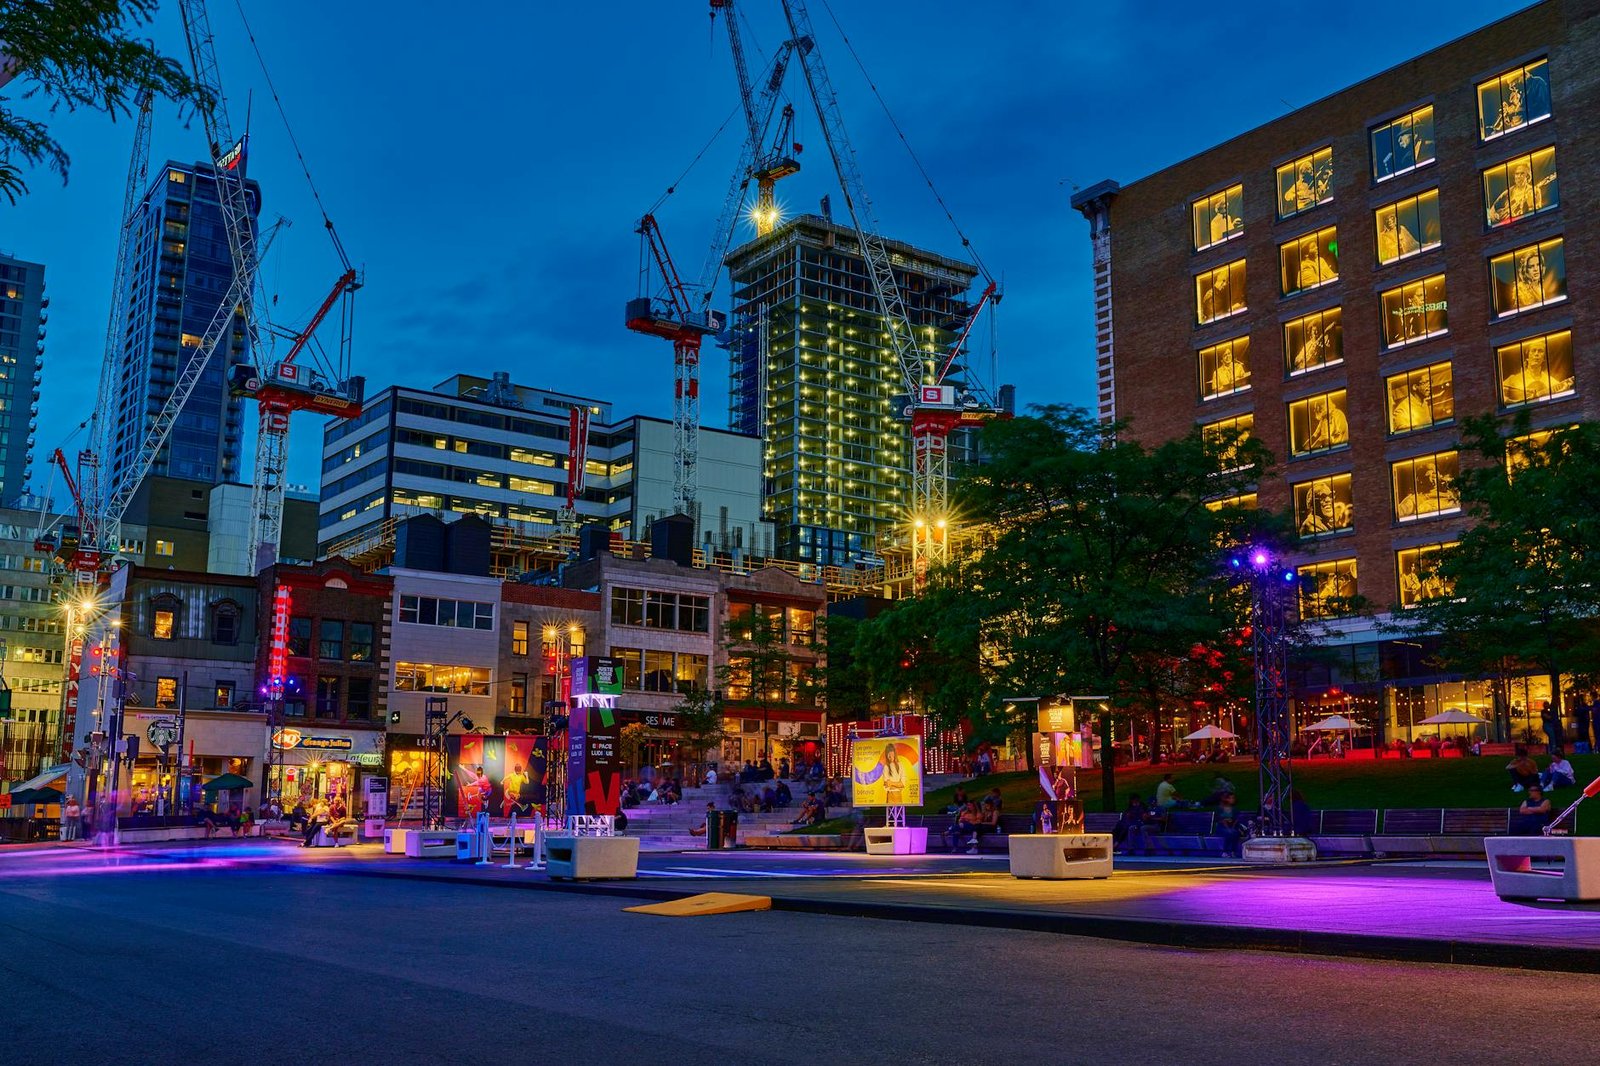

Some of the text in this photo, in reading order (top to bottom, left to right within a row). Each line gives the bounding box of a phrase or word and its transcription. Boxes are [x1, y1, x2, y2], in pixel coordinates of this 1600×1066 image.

[282, 366, 293, 376] S
[925, 390, 938, 400] S
[79, 571, 94, 583] B
[303, 738, 329, 748] Orange
[329, 739, 351, 748] Julius
